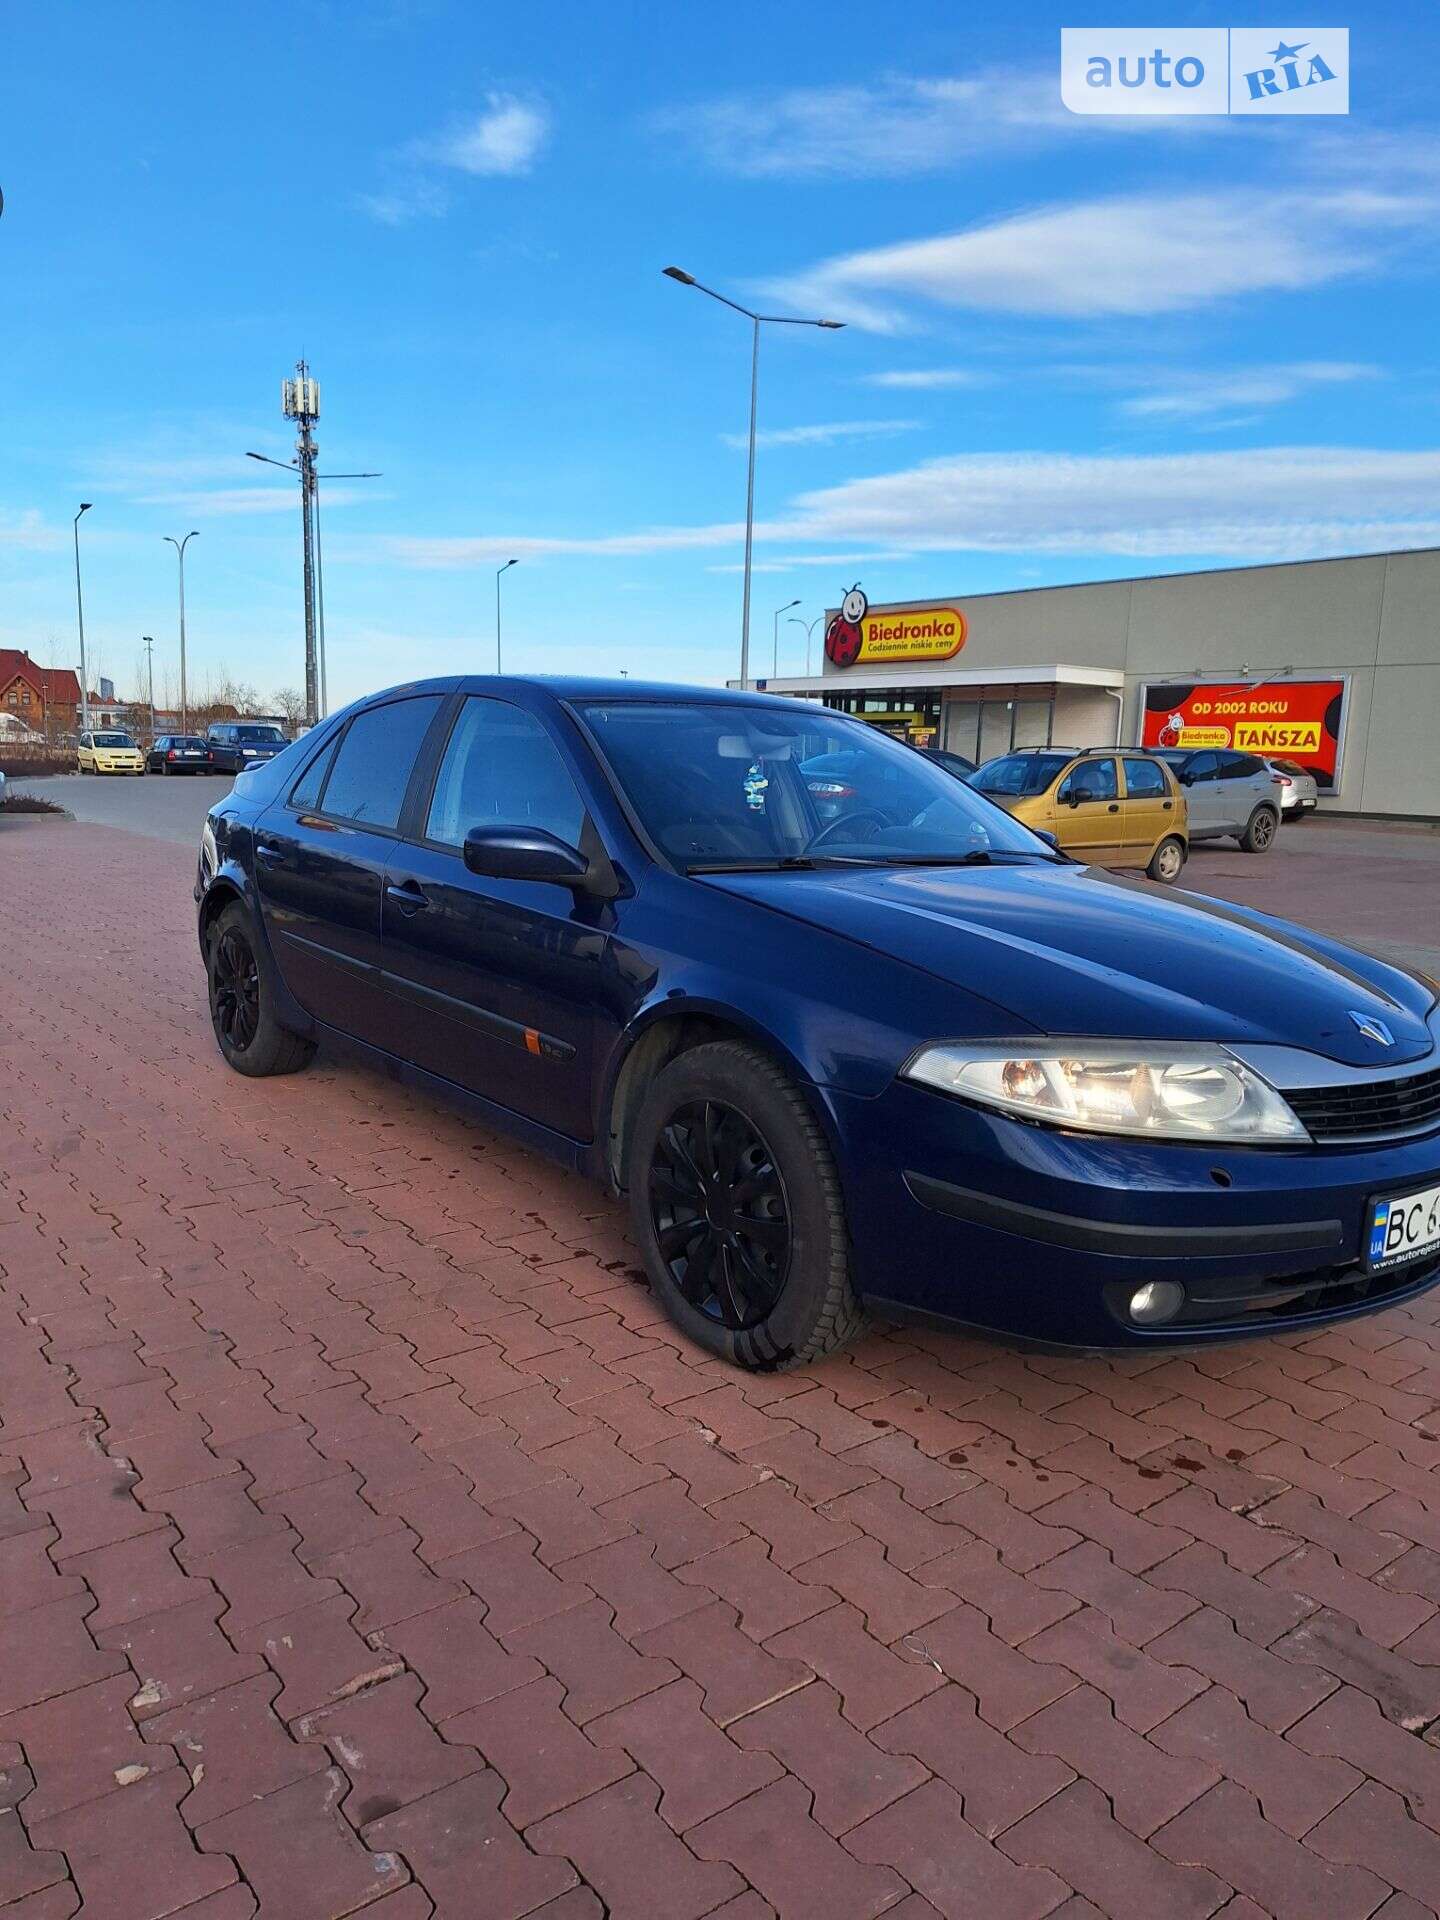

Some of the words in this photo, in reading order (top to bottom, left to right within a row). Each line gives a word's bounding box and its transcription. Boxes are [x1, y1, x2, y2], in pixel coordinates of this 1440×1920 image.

[868, 618, 956, 642] Biedronka
[868, 641, 908, 652] Codziennie
[910, 639, 933, 650] niskie
[935, 639, 954, 649] ceny
[1192, 702, 1212, 715] OD
[1214, 702, 1247, 715] 2002
[1249, 701, 1289, 714] ROKU
[1182, 730, 1226, 740] Biedronka
[1238, 724, 1318, 747] TAŃSZA
[1386, 1203, 1423, 1251] BC
[1427, 1194, 1440, 1236] 6
[1370, 1240, 1383, 1256] UA
